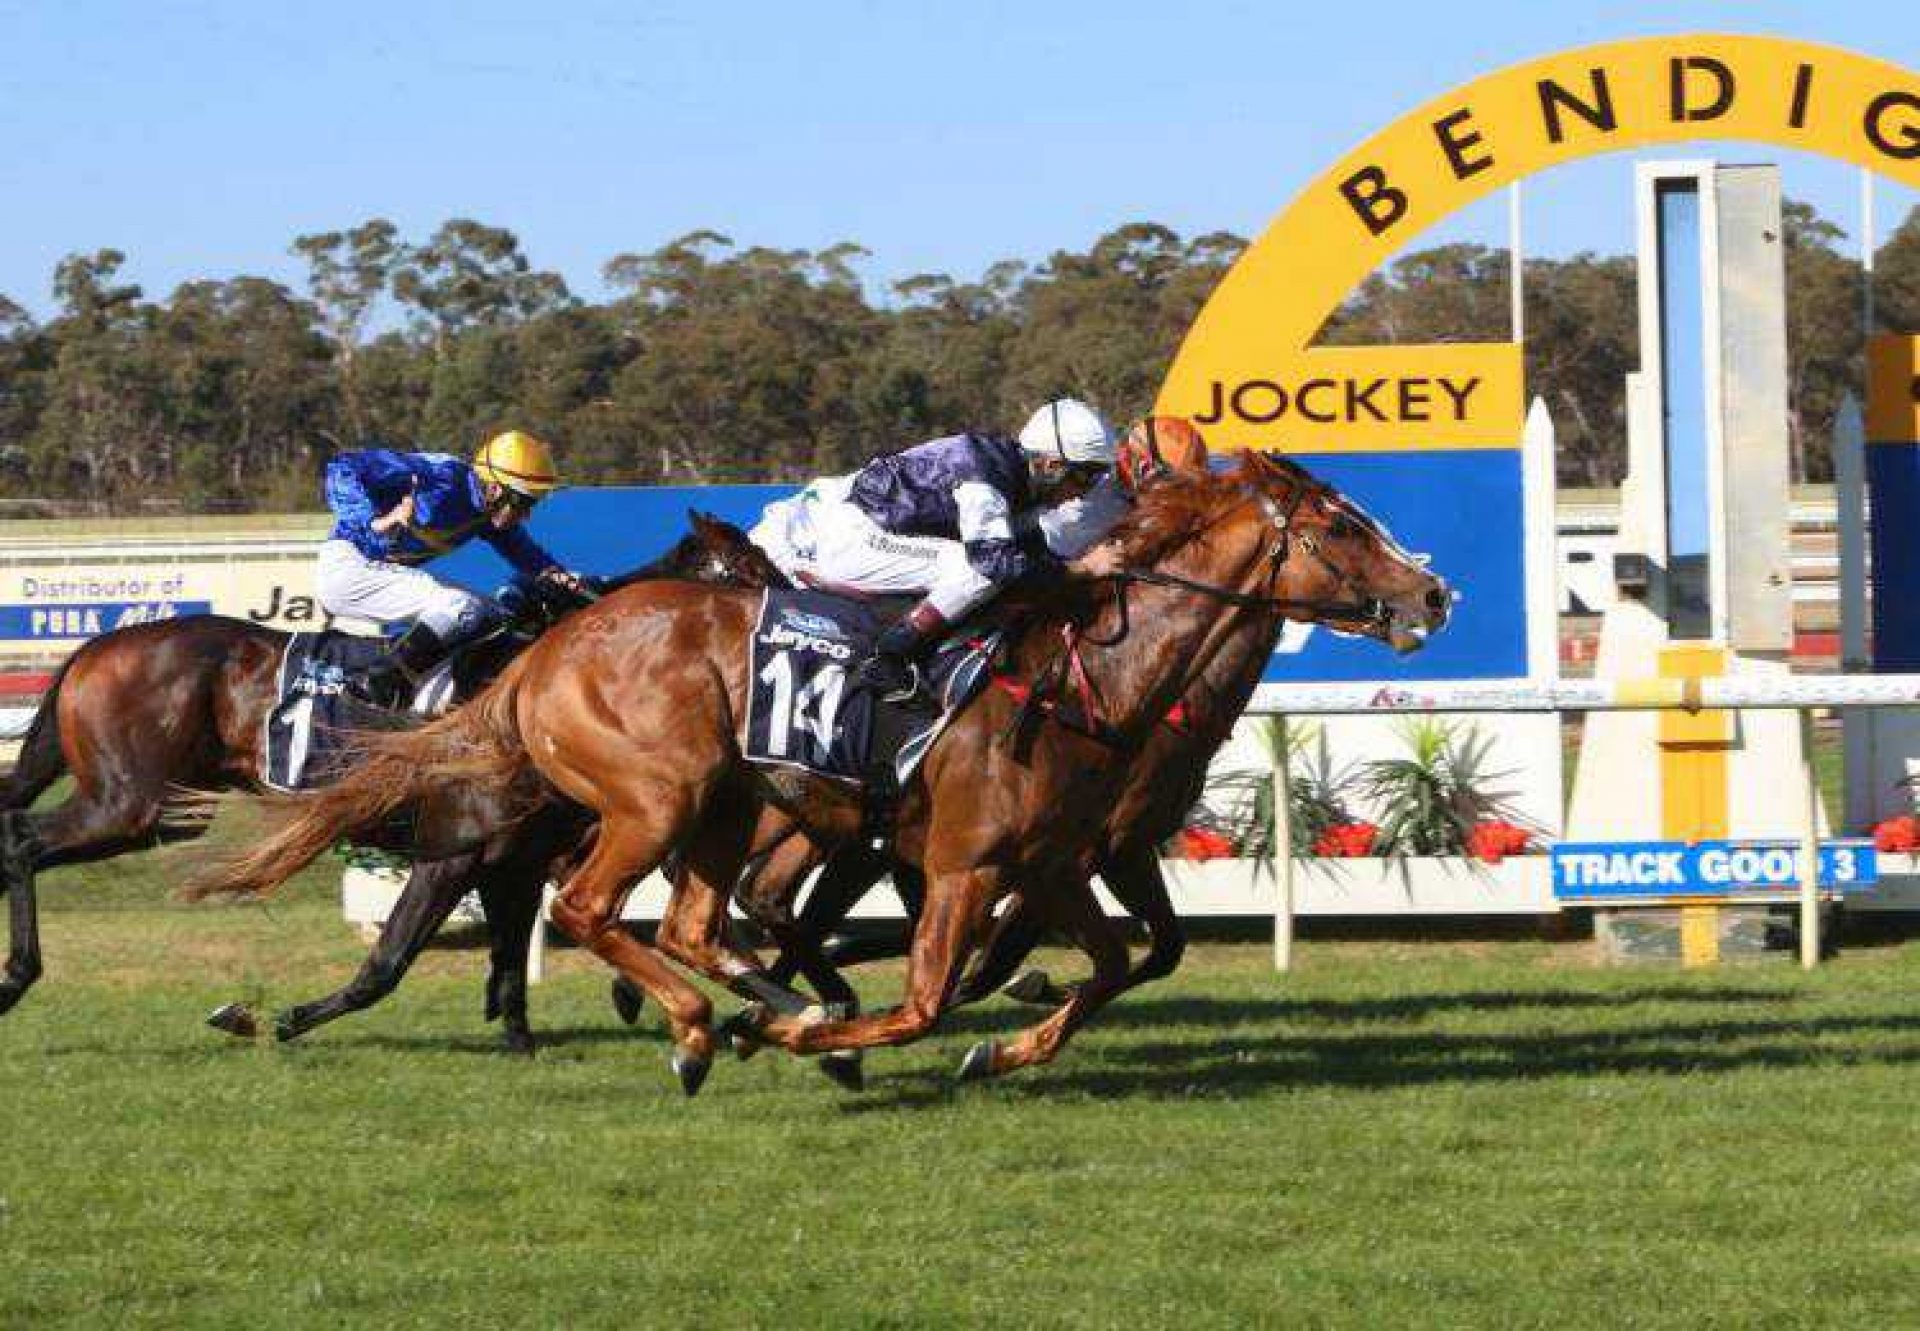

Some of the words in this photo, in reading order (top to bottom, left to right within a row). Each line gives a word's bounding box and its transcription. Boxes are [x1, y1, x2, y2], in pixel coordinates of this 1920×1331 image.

[1194, 376, 1482, 425] JOCKEY
[22, 575, 150, 598] Distributor
[161, 573, 184, 597] of
[759, 650, 848, 768] 14
[280, 697, 314, 787] 1
[1558, 852, 1686, 885] TRACK
[1699, 849, 1823, 884] GOO
[1833, 849, 1855, 881] 3
